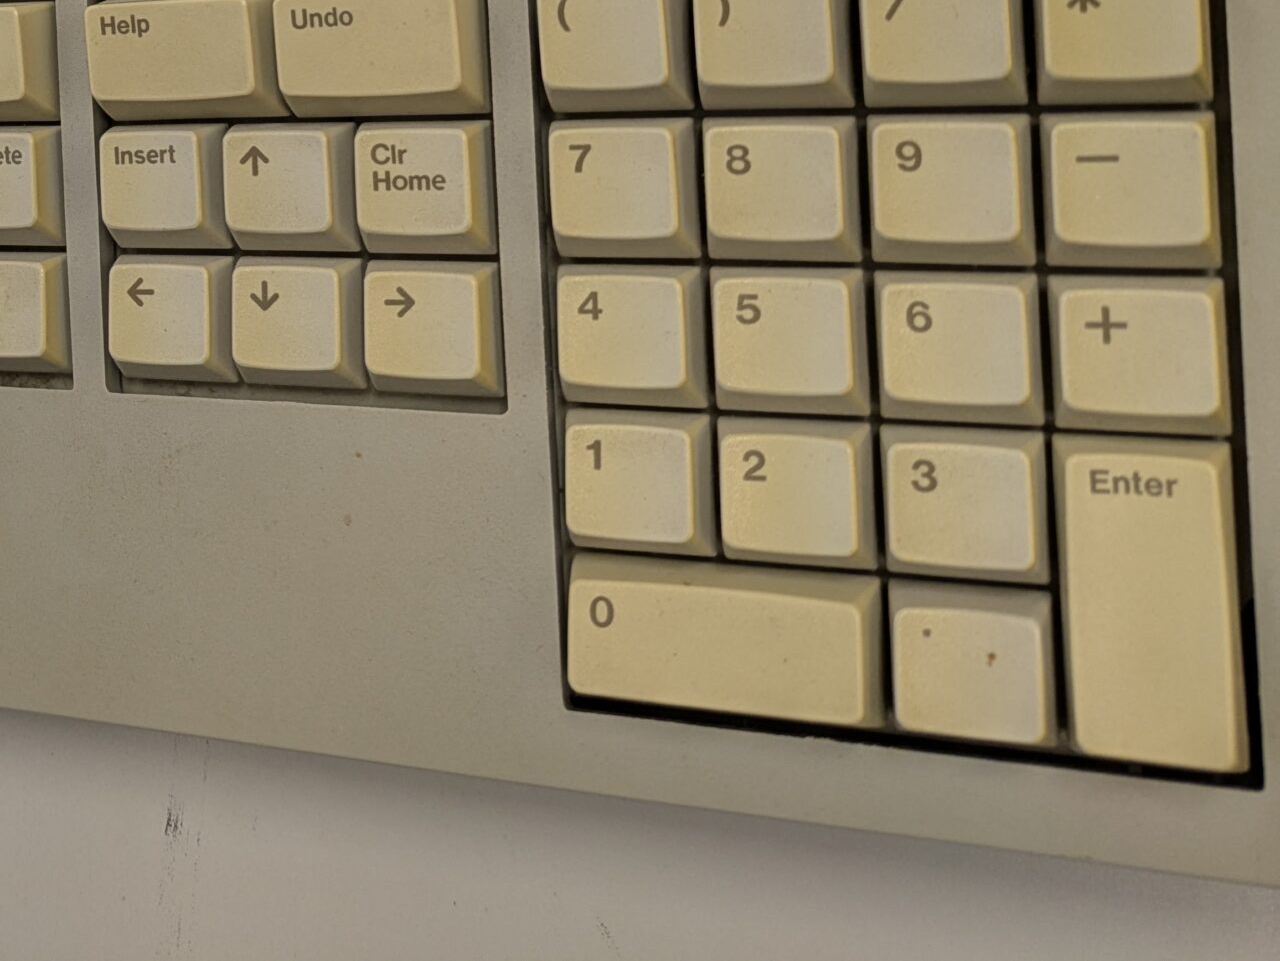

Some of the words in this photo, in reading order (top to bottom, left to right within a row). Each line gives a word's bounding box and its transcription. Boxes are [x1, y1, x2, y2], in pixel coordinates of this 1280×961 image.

[99, 14, 150, 38] Help
[290, 6, 354, 30] Undo
[113, 144, 177, 166] Insert
[370, 142, 408, 166] Clr
[568, 143, 592, 174] 7
[725, 144, 752, 176] 8
[894, 140, 923, 173] 9
[372, 170, 447, 192] Home
[577, 290, 604, 321] 4
[735, 293, 762, 326] 5
[905, 300, 933, 334] 6
[1084, 305, 1128, 345] +
[585, 439, 602, 471] 1
[742, 449, 768, 482] 2
[910, 458, 938, 494] 3
[1089, 468, 1179, 498] Enter
[589, 595, 615, 629] 0
